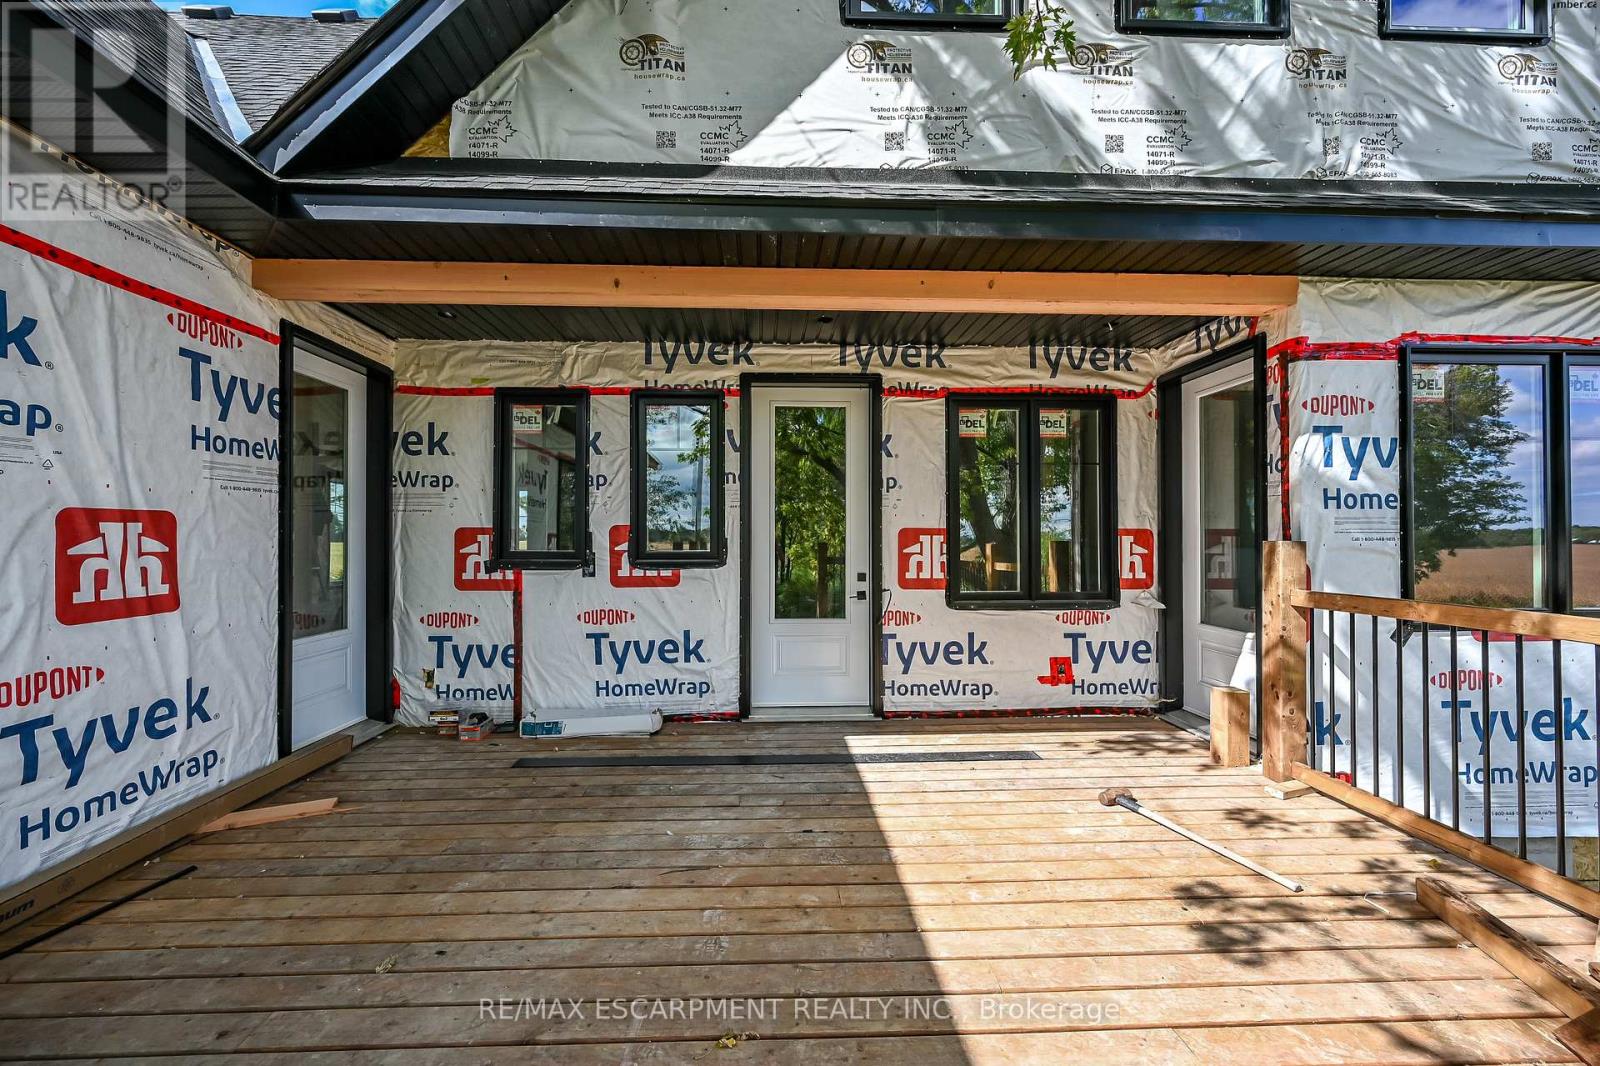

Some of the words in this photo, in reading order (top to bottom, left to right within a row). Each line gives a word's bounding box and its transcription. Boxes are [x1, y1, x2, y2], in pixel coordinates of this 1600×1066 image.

[638, 57, 685, 72] TITAN
[865, 63, 912, 74] TITAN
[1088, 65, 1133, 76] TITAN
[1302, 69, 1347, 80] TITAN
[1515, 75, 1557, 87] TITAN
[698, 113, 743, 121] Requirements
[469, 127, 498, 135] CCMC
[700, 132, 729, 140] CCMC
[1360, 137, 1386, 146] CCMC
[177, 313, 236, 349] DUPONT
[1418, 379, 1442, 390] DEL
[1574, 381, 1598, 391] DEL
[1311, 394, 1366, 416] DUPONT
[520, 416, 540, 424] DEL
[965, 420, 984, 428] DEL
[1046, 420, 1065, 428] DEL
[427, 612, 473, 629] DUPONT
[584, 609, 629, 626] DUPONT
[1062, 610, 1104, 626] DUPONT
[586, 629, 705, 675] Tyvek
[882, 632, 989, 675] Tyvek
[1064, 632, 1159, 673] Tyve
[0, 665, 92, 709] DUPONT
[596, 679, 710, 698] HomeWrap
[883, 680, 993, 700] HomeWrap
[1, 676, 212, 790] Tyvek
[1441, 697, 1591, 755] Tyvek
[19, 749, 219, 850] HomeWrap
